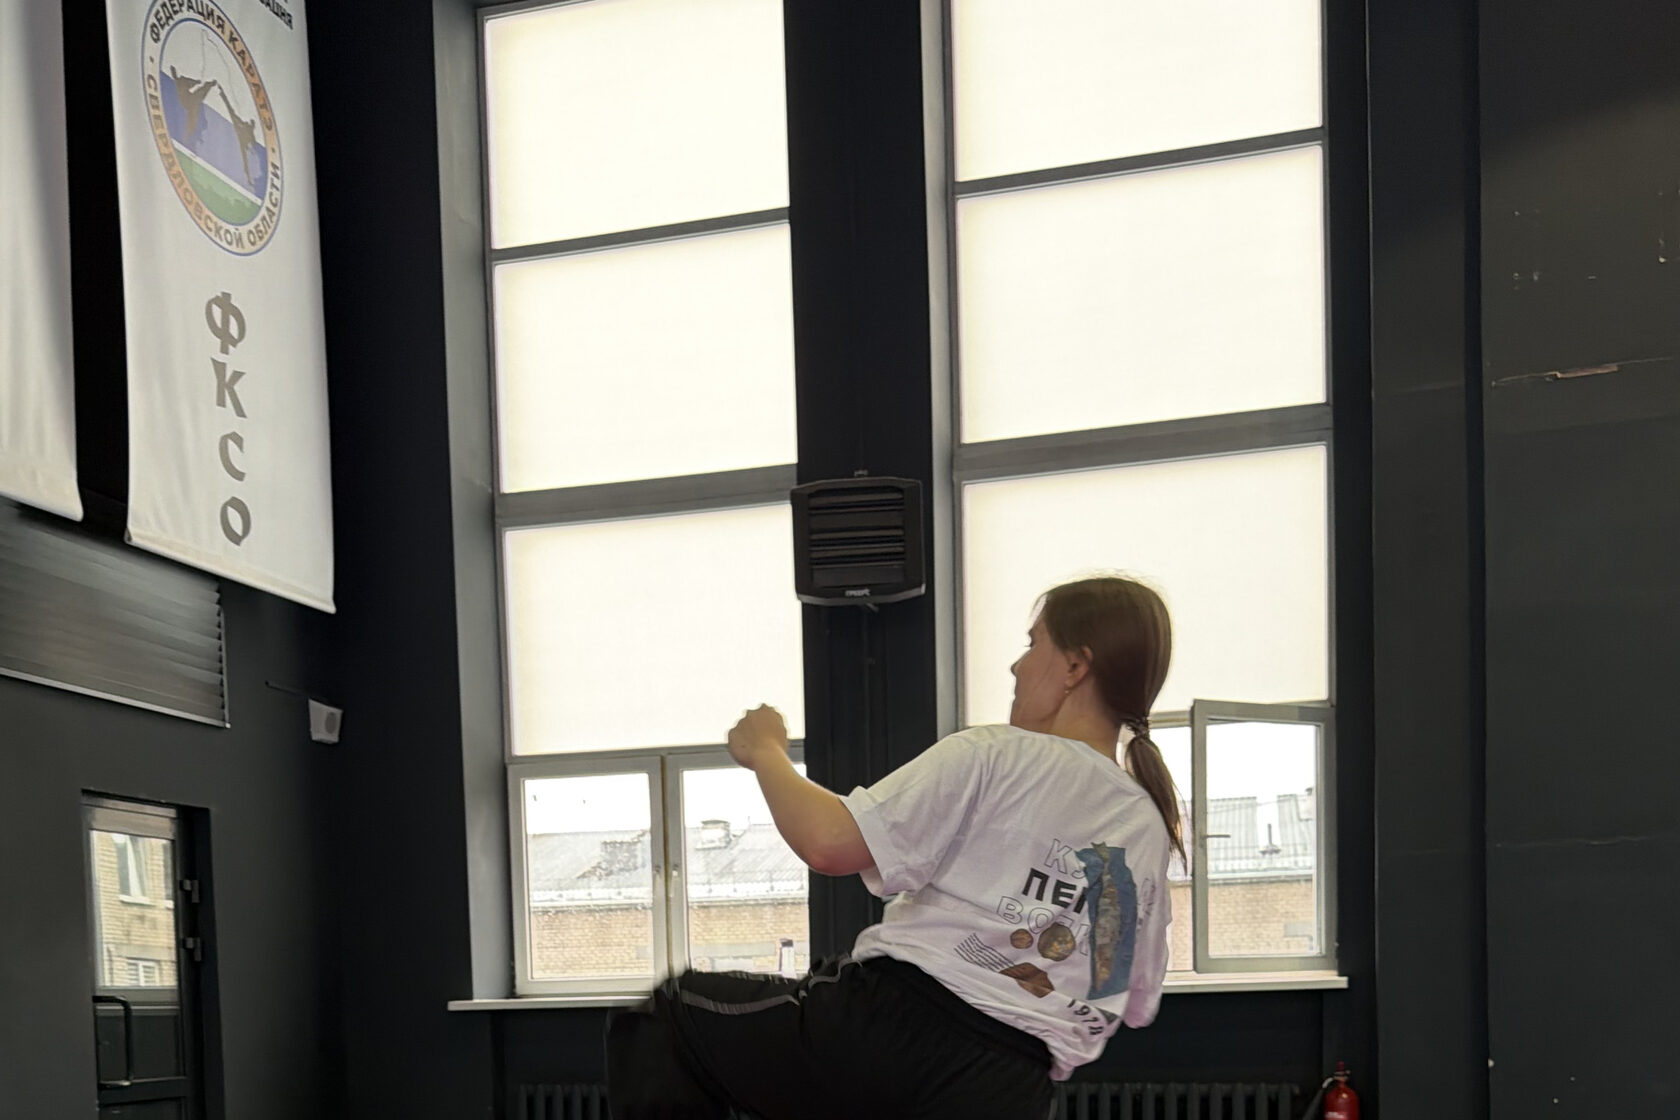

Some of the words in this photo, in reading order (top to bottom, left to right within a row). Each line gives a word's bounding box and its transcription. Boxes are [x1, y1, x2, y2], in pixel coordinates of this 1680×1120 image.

[150, 0, 225, 43] ФЕДЕРАЦИЯ
[228, 31, 273, 131] КАРАТЭ
[147, 74, 244, 249] СВЕРДЛОВСКОЙ
[247, 162, 280, 248] ОБЛАСТИ
